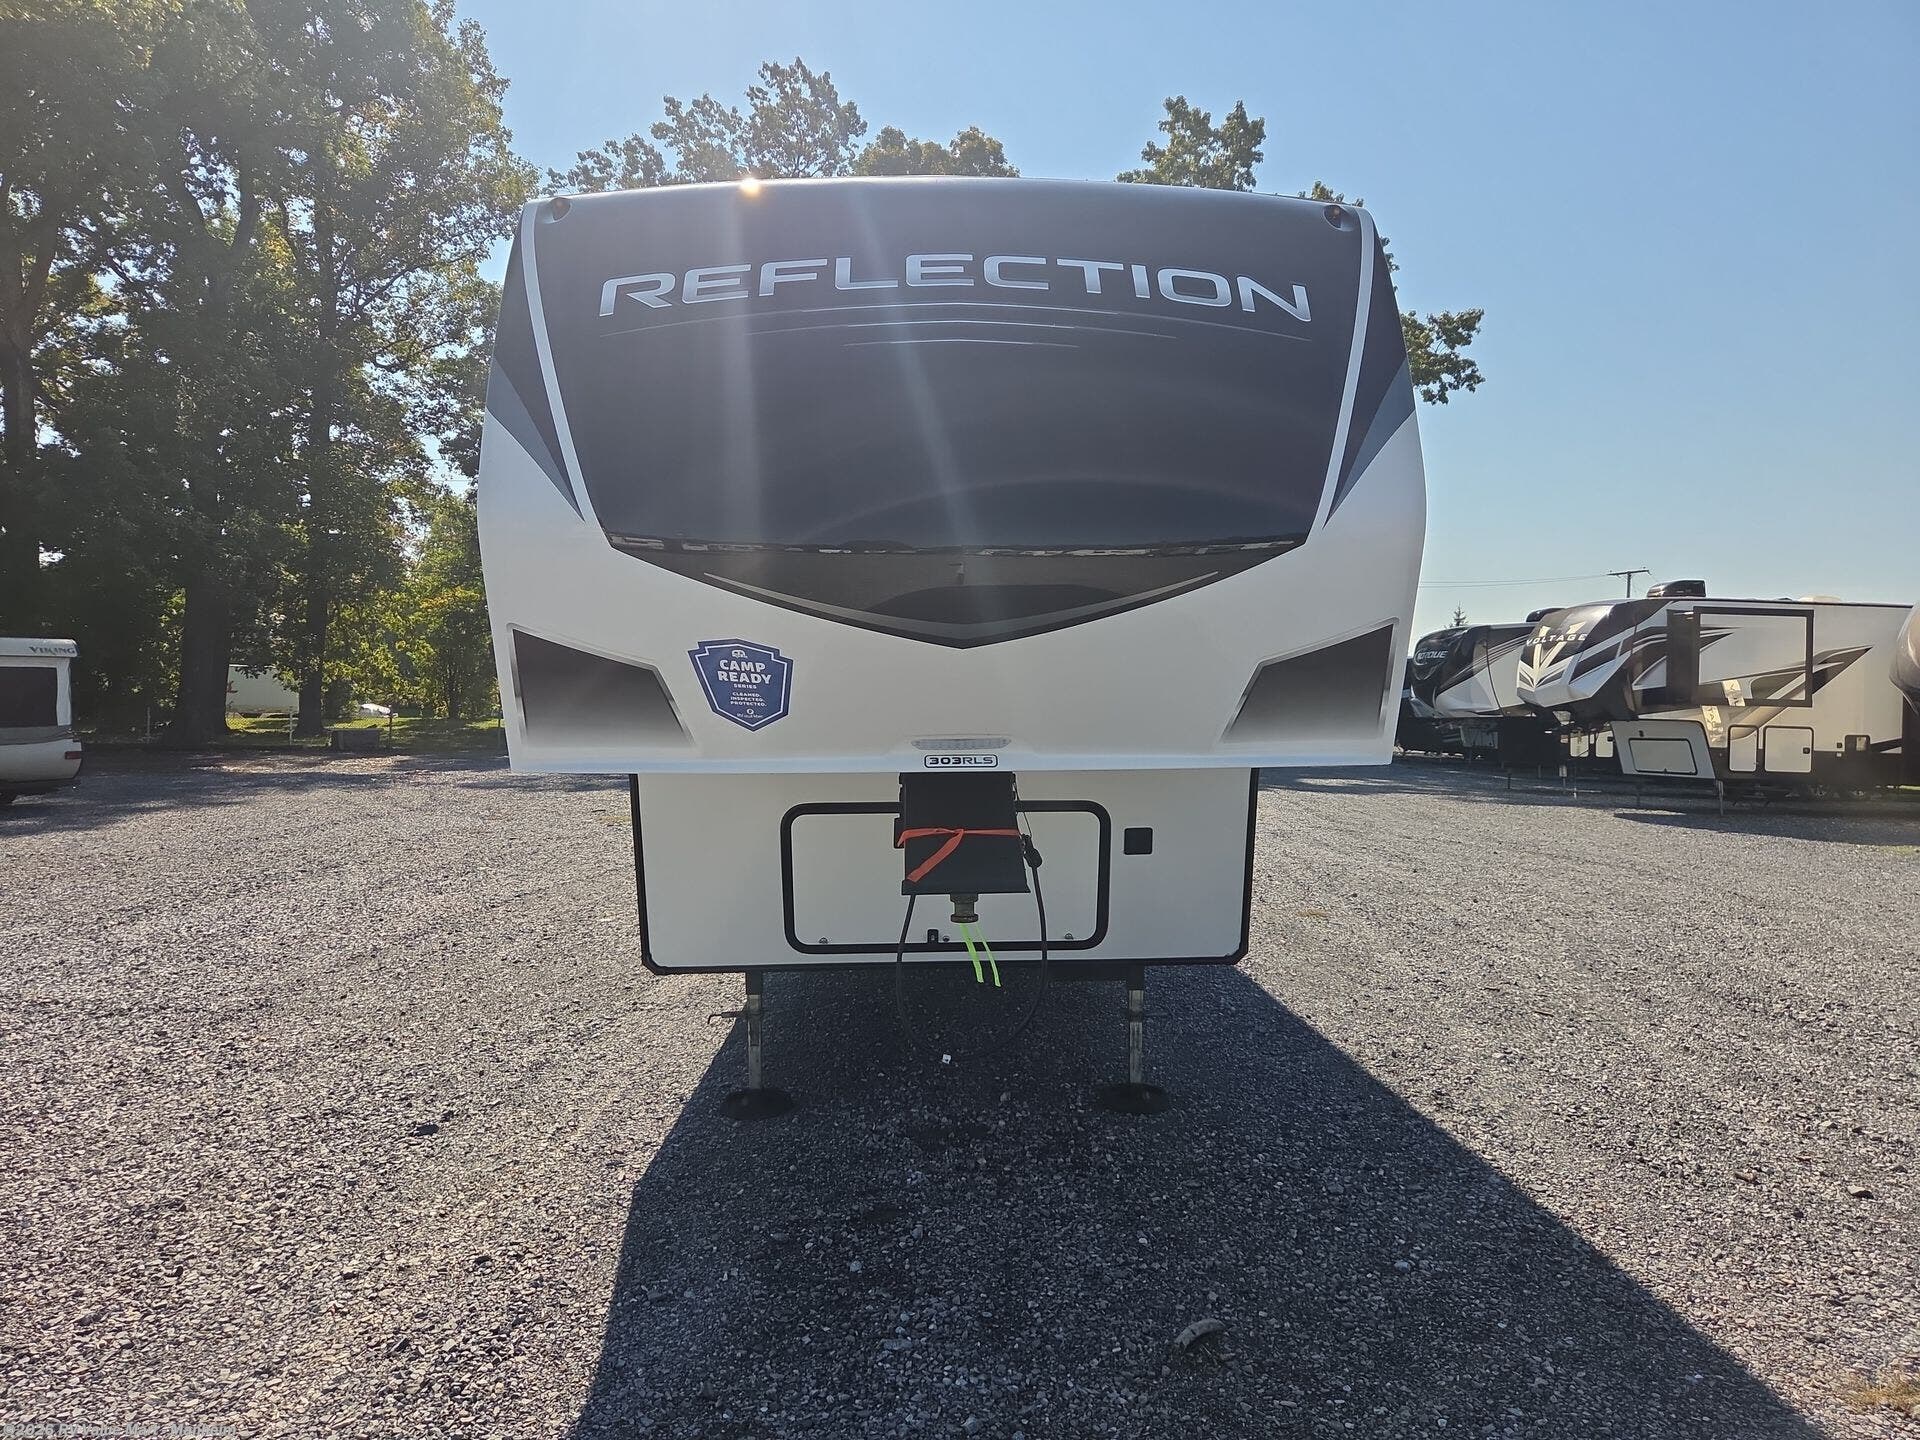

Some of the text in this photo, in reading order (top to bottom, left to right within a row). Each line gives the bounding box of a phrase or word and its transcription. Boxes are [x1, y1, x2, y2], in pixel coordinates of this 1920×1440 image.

[598, 252, 1313, 323] REFLECTION
[1526, 633, 1588, 647] VOLTAGE
[29, 646, 76, 656] VIKING
[719, 659, 766, 673] CAMP
[717, 670, 772, 684] READY
[929, 756, 994, 765] 303RLS
